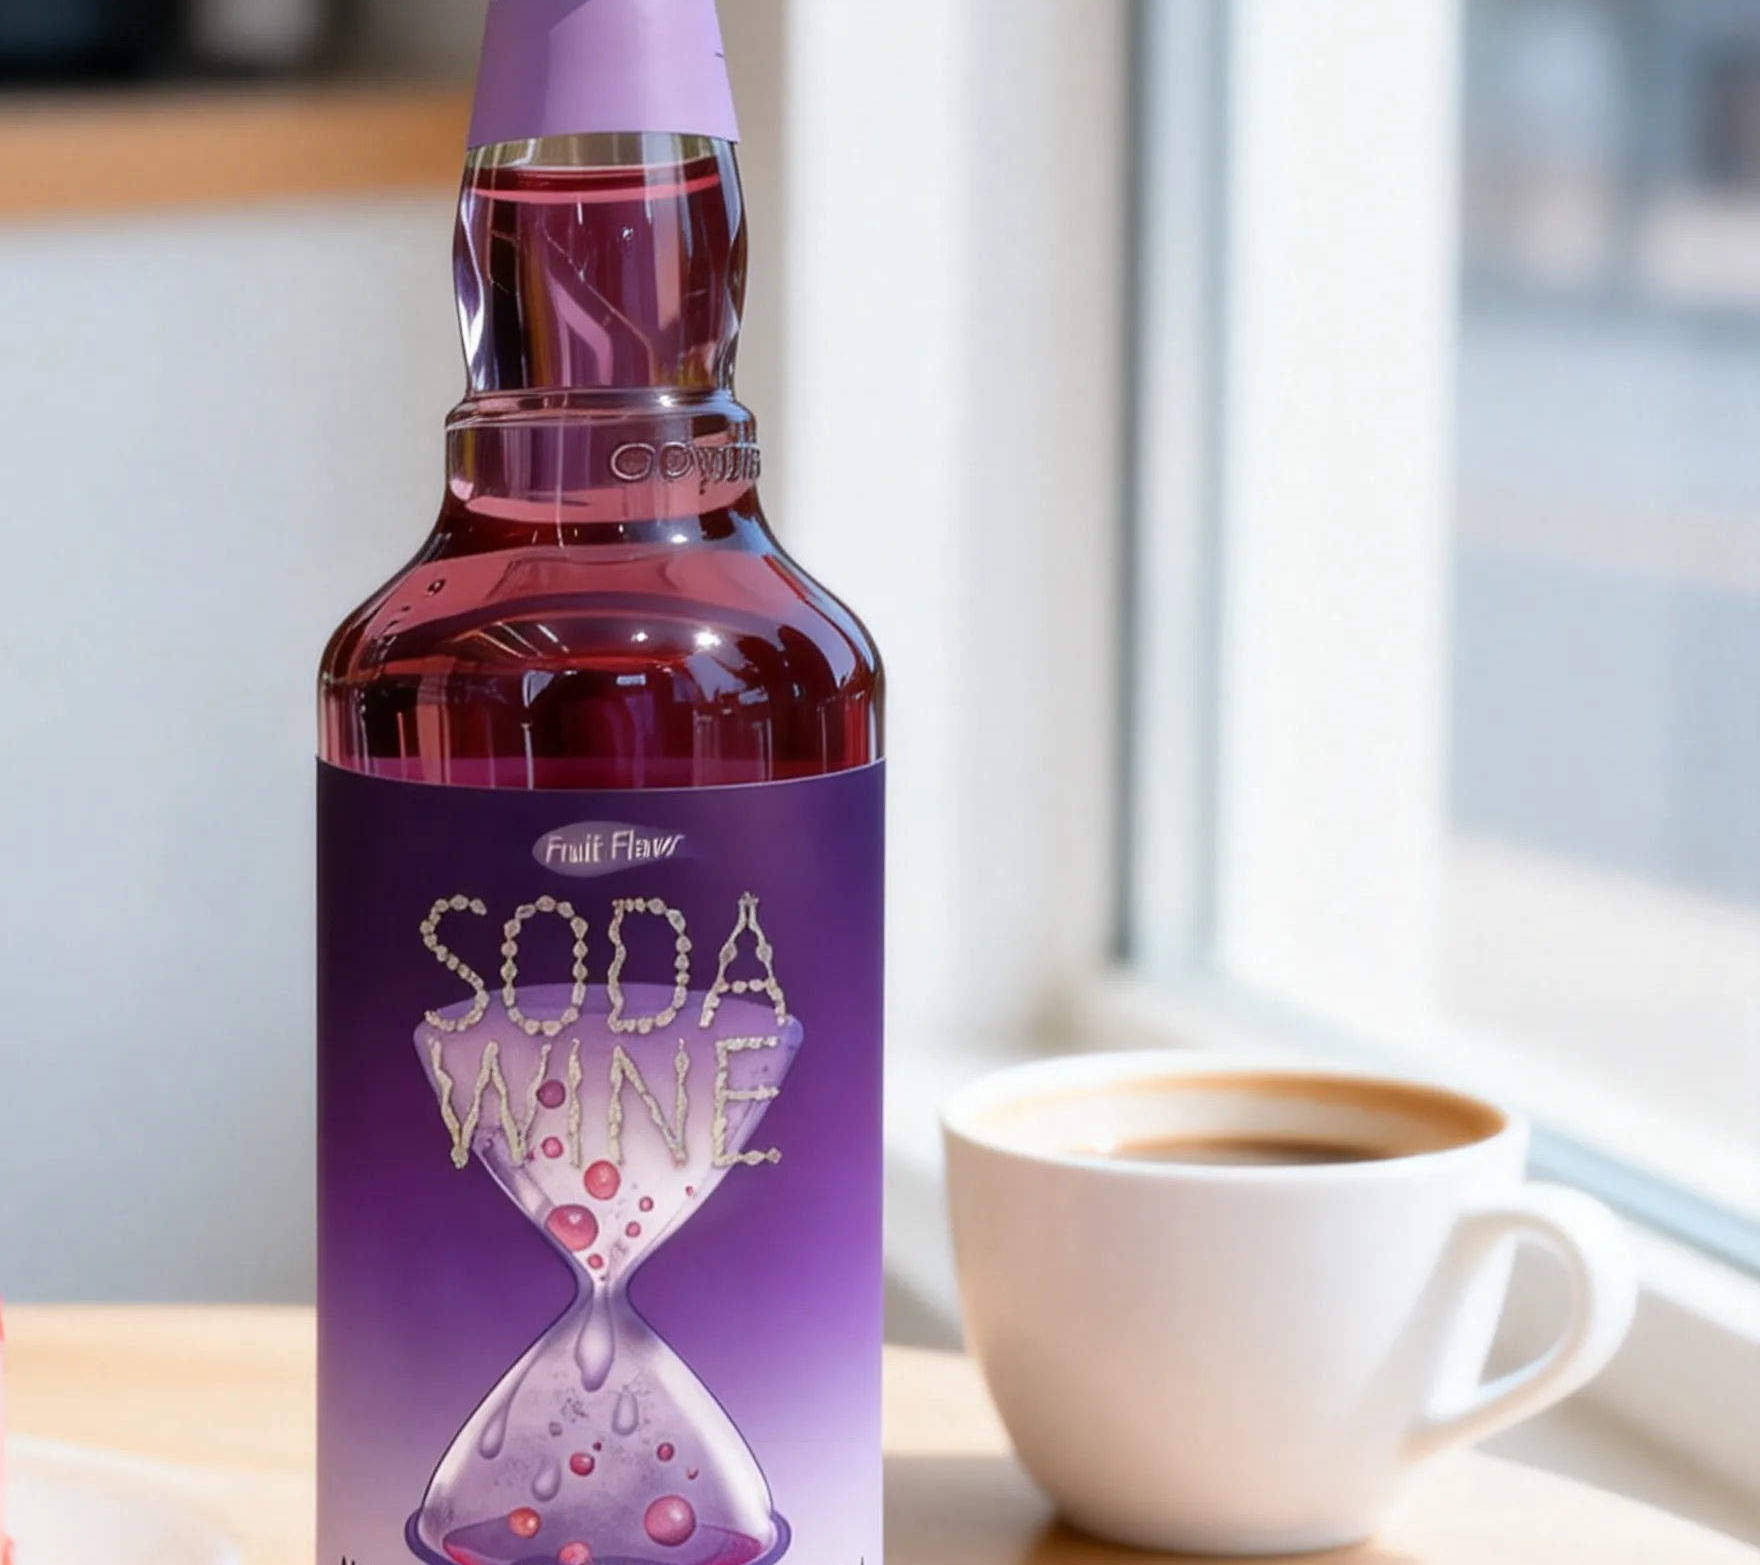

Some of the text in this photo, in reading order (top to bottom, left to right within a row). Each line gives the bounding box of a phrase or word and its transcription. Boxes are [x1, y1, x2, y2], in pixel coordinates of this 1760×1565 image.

[545, 834, 603, 864] Fruit
[419, 892, 789, 1035] SODA
[428, 1038, 782, 1169] WINE
